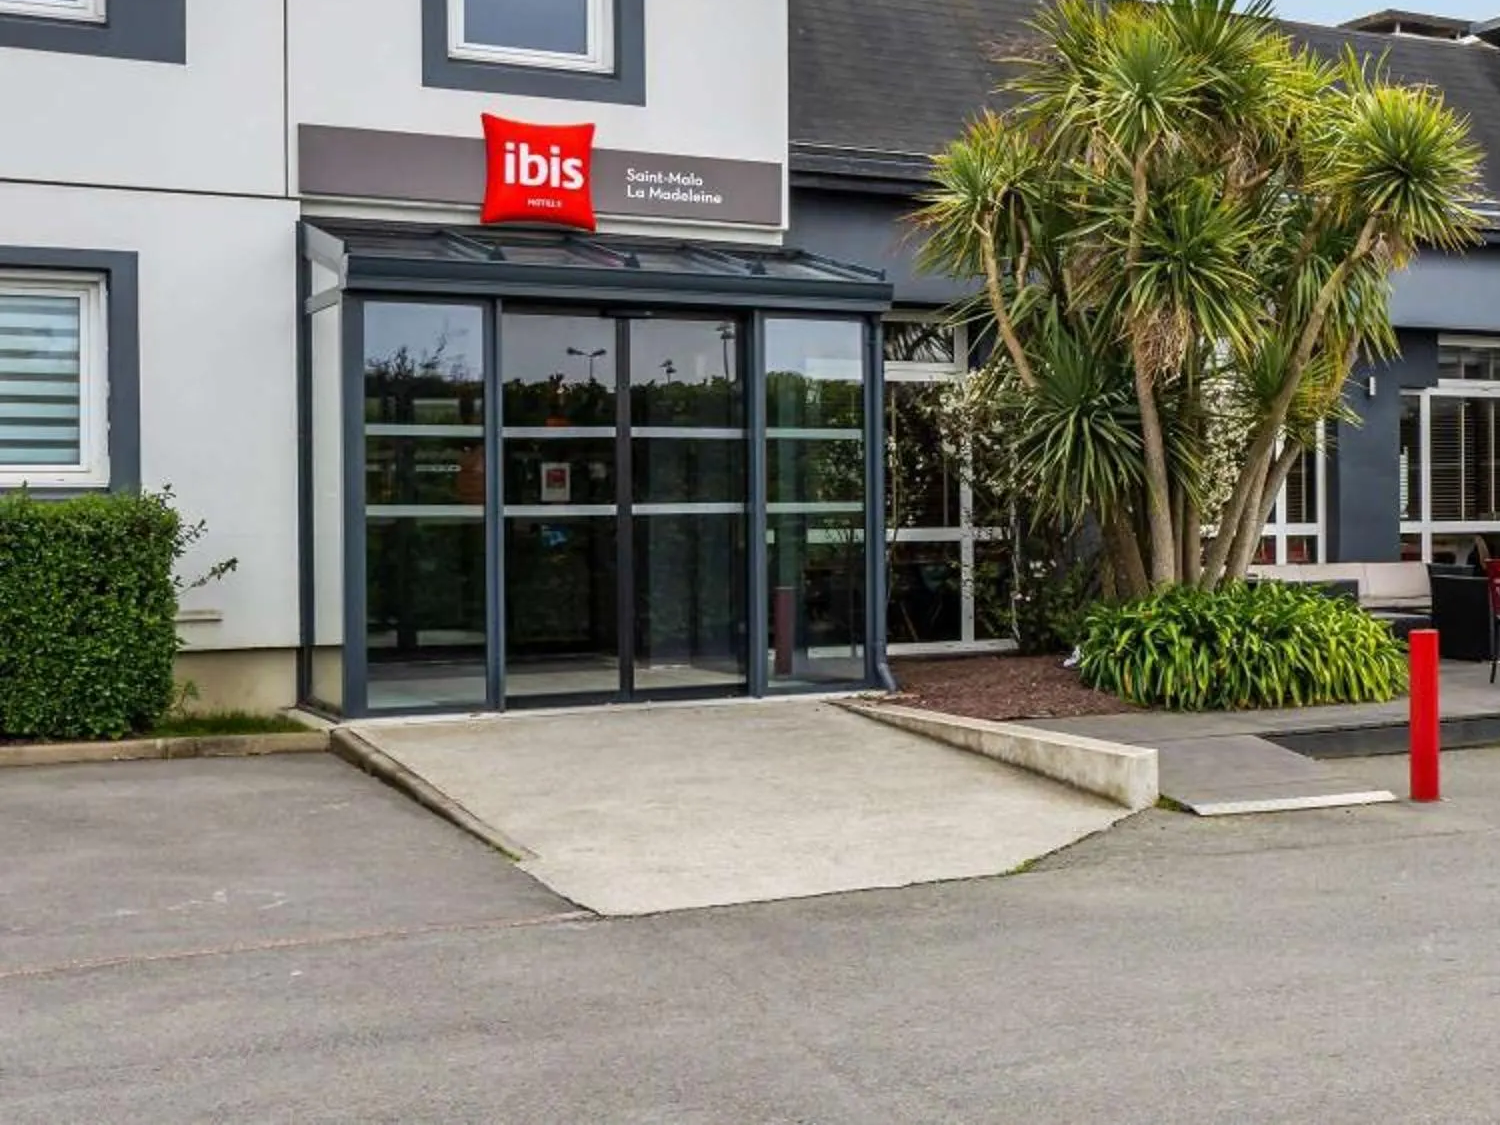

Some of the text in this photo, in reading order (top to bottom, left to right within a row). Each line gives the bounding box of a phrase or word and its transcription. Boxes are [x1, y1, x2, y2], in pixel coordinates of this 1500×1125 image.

[504, 142, 584, 190] ibis
[626, 168, 703, 186] Saint-Malo
[627, 185, 722, 204] La Madeleine
